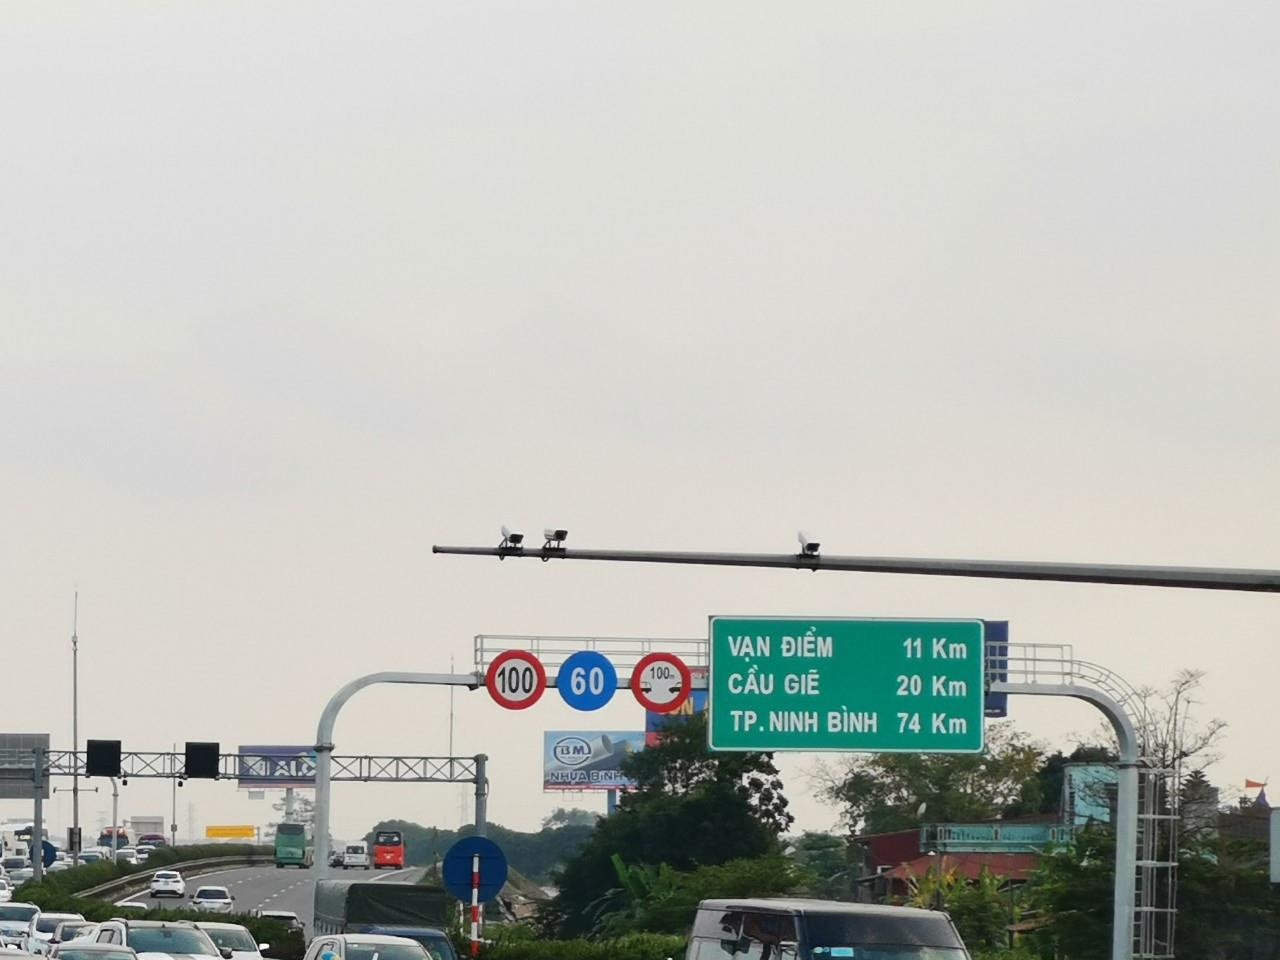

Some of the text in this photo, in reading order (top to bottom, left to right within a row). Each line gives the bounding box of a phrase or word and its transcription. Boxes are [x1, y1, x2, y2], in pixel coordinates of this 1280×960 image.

[728, 626, 967, 662] VẠN ĐIỂM 11 Km
[497, 667, 534, 695] 100
[570, 667, 605, 696] 60
[728, 664, 967, 697] CẦU GIẼ 20 Km
[827, 705, 878, 733] BÌNH
[897, 713, 921, 734] 74
[932, 713, 967, 734] Km
